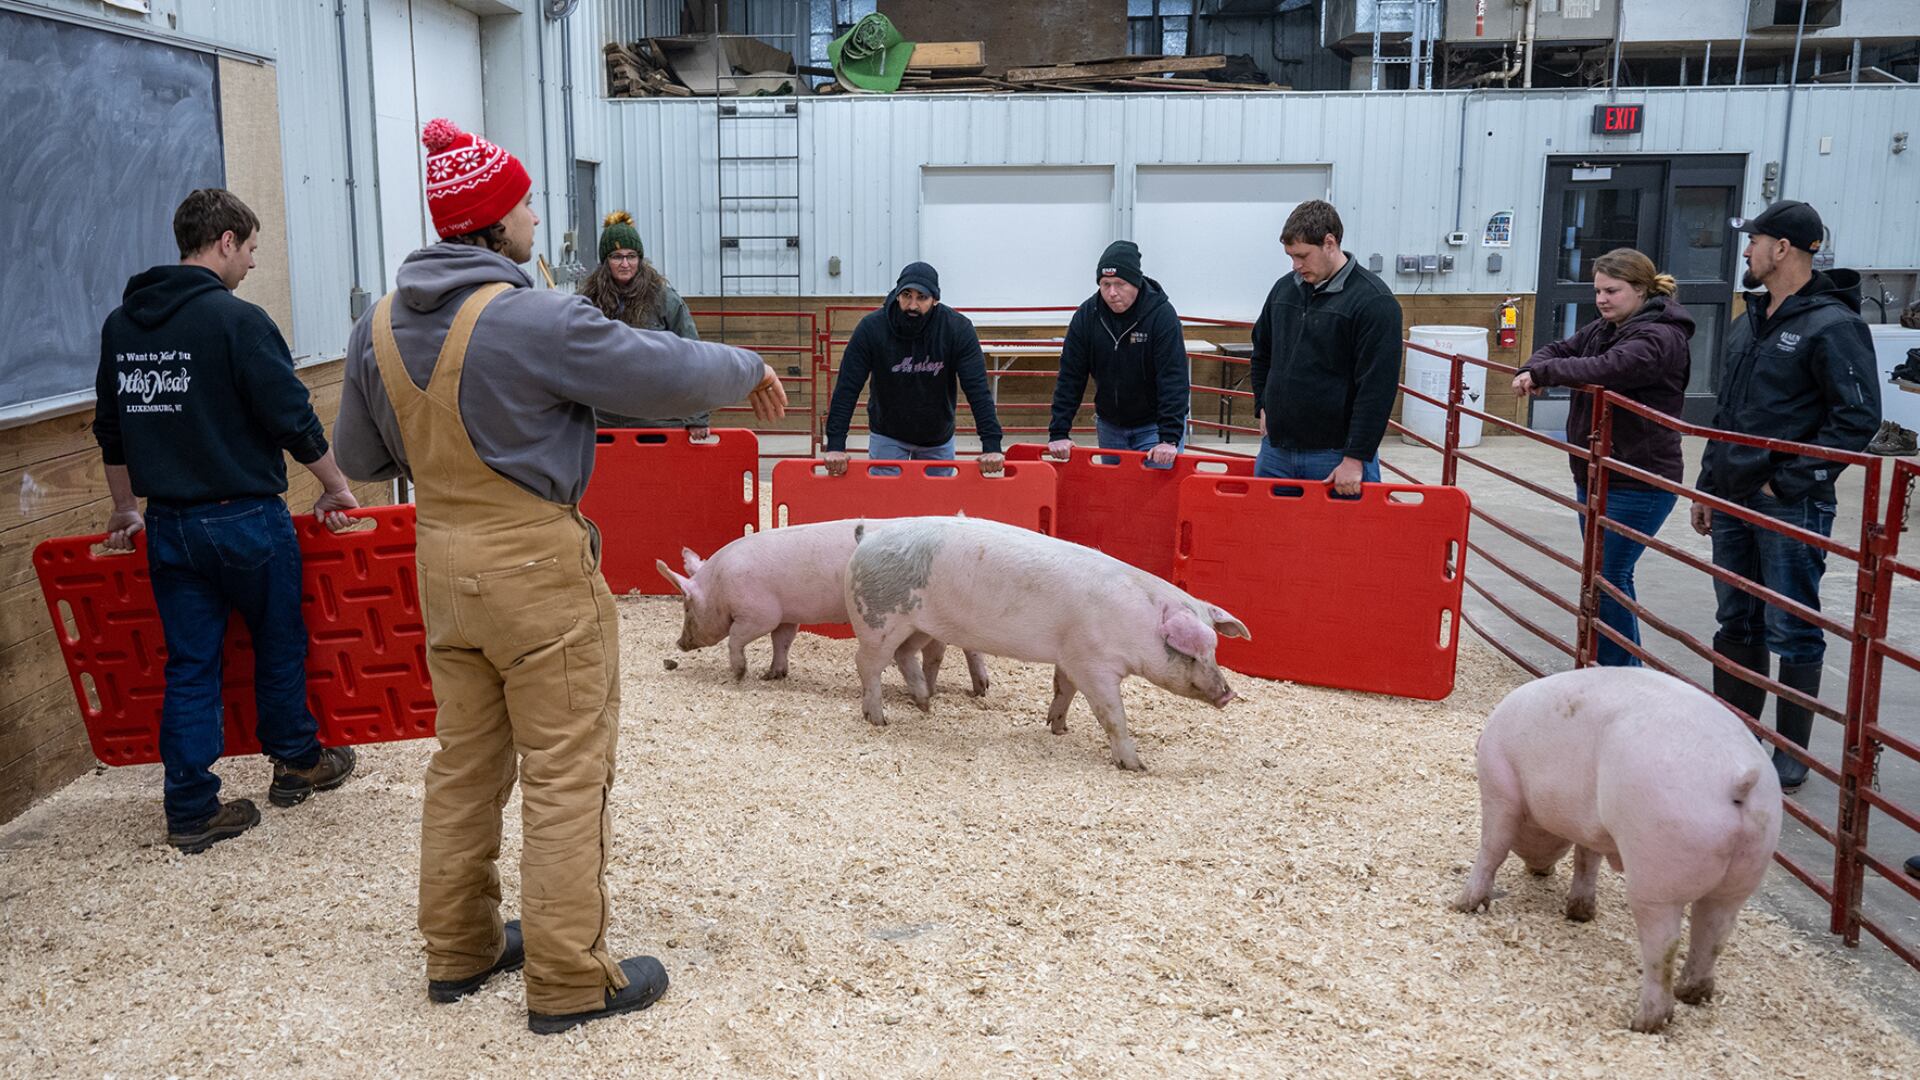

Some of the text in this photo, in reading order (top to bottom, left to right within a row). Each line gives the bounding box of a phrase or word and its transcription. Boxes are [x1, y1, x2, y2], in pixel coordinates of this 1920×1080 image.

[1605, 107, 1638, 130] EXIT
[126, 352, 148, 362] Want
[149, 352, 158, 361] to
[126, 404, 175, 413] LUXEMBURG,
